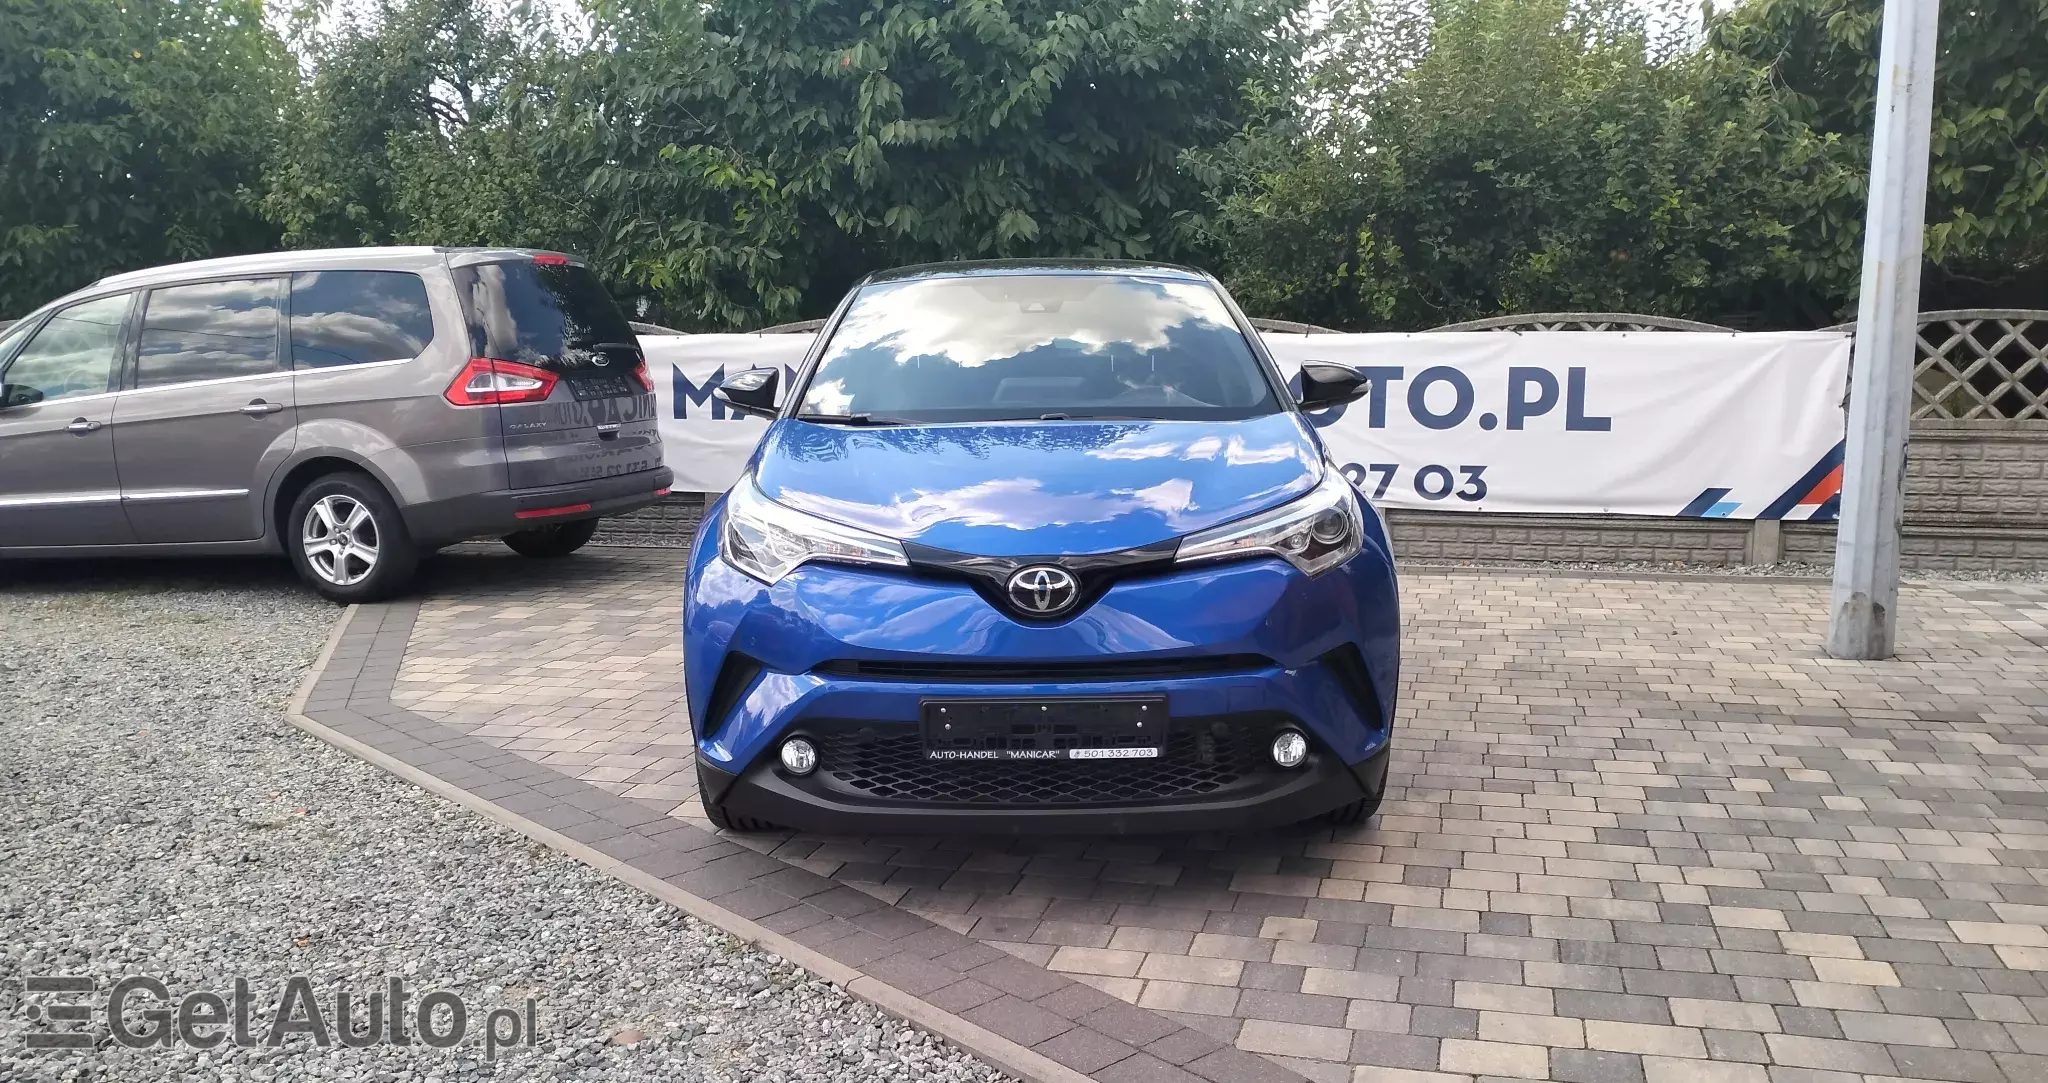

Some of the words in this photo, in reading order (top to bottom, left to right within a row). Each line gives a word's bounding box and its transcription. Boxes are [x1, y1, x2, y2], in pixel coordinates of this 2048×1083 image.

[929, 750, 999, 759] AUTO-HANDEL
[1006, 750, 1060, 759] "MANICAR"
[1084, 750, 1104, 758] 501
[1107, 749, 1130, 758] 332
[1132, 748, 1154, 757] 703
